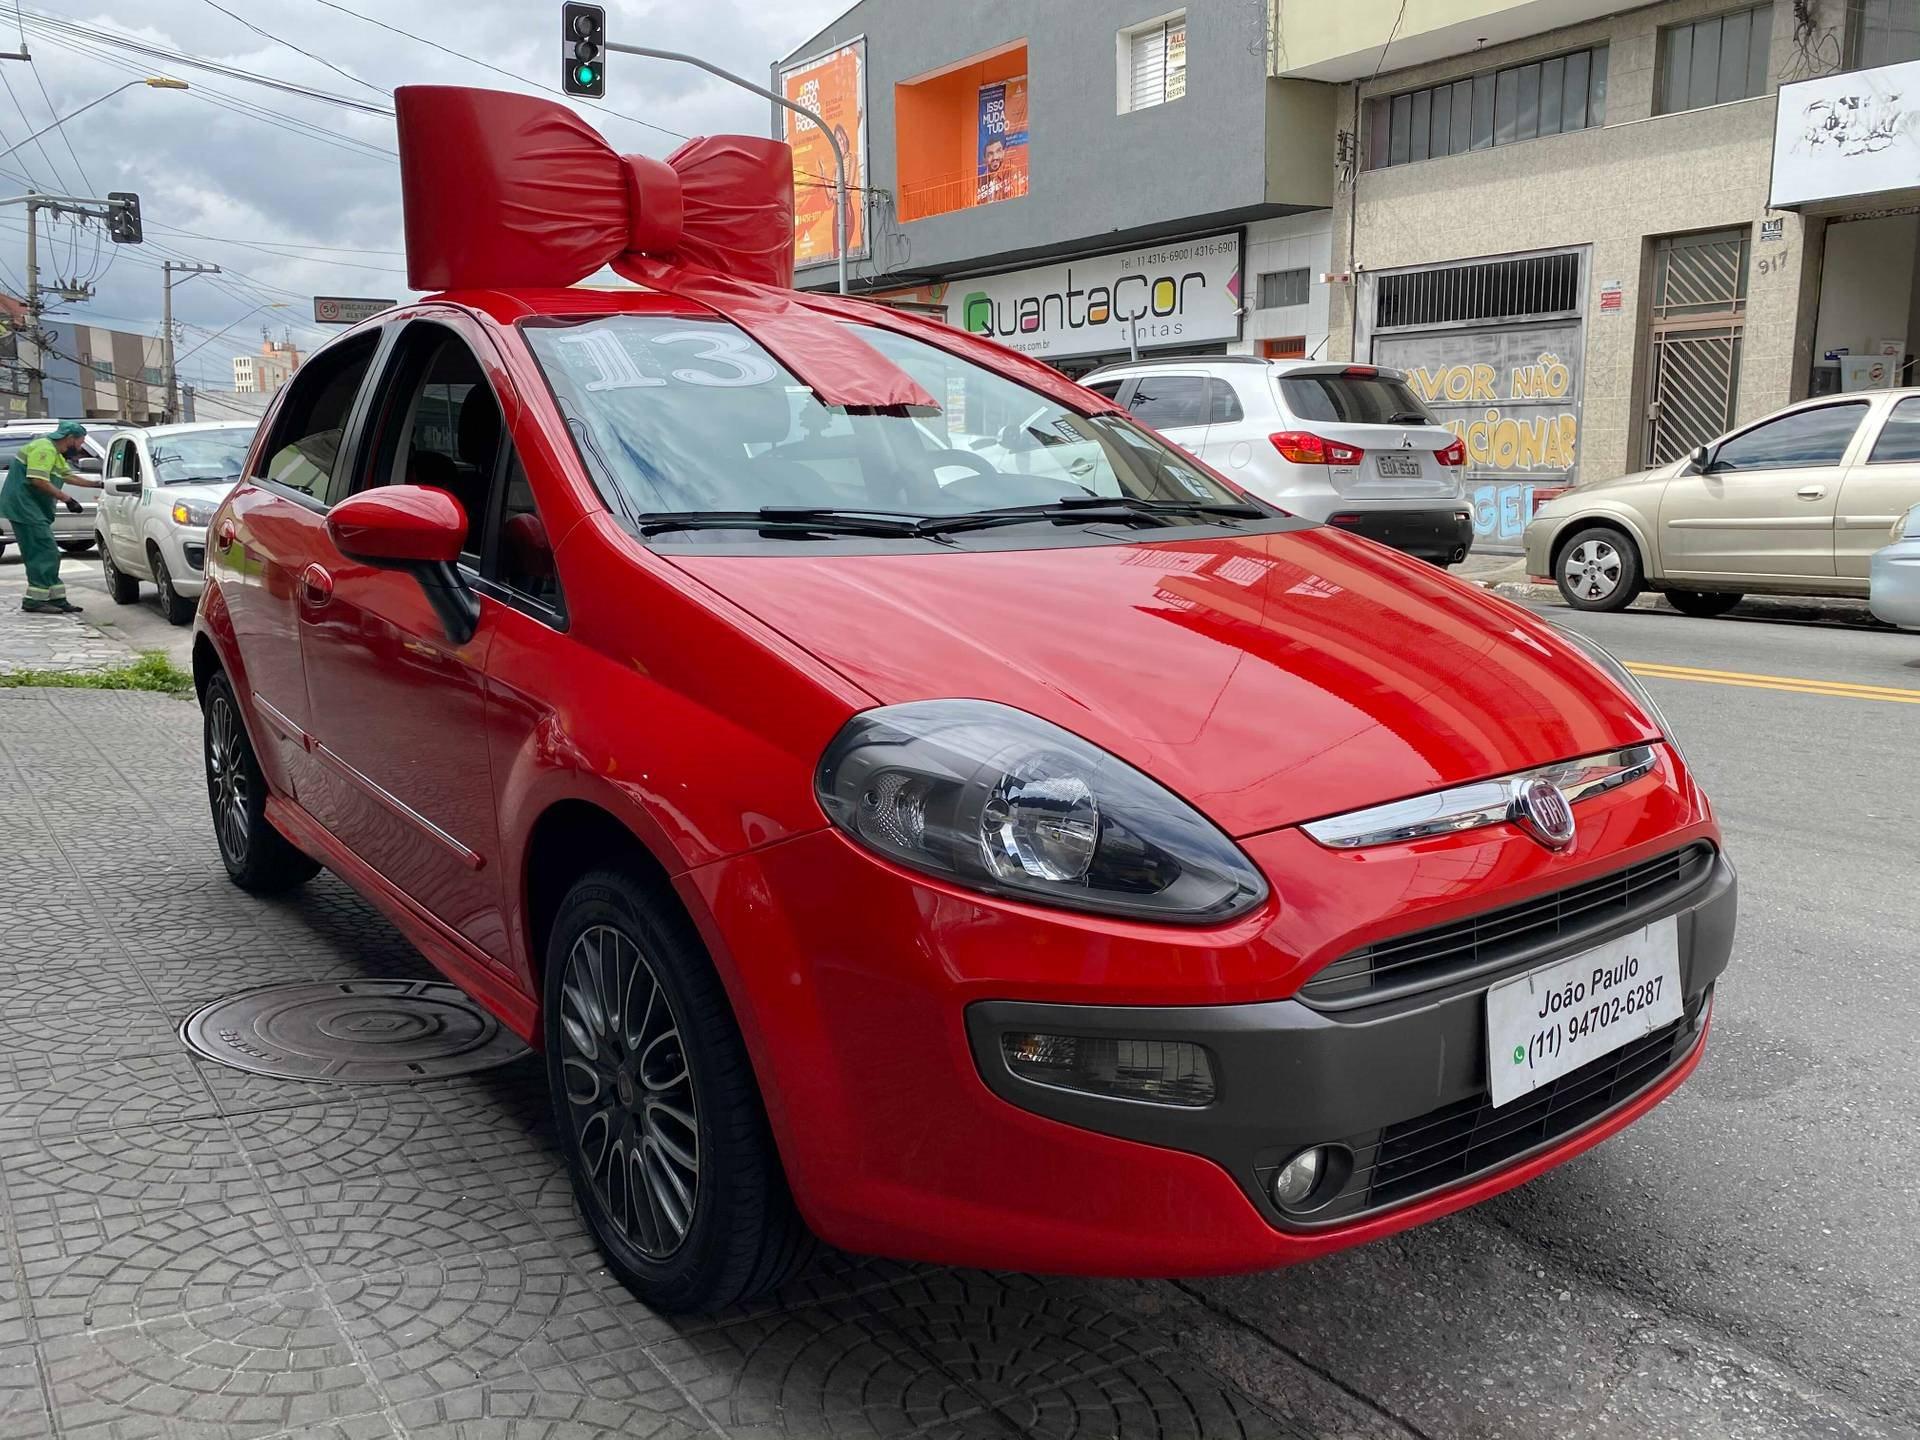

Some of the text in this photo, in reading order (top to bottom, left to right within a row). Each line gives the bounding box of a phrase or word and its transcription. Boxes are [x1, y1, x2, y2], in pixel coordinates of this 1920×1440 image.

[983, 110, 1006, 126] MUDA
[986, 99, 1005, 113] ISSO
[986, 120, 1010, 135] TUDO
[1758, 248, 1789, 275] 917
[323, 305, 336, 314] 50
[1120, 321, 1183, 341] tntas
[559, 328, 778, 393] 13
[1511, 352, 1568, 399] NÃO
[1535, 793, 1568, 827] FIAT
[1538, 955, 1639, 1019] João Paulo
[1528, 975, 1663, 1069] (11) 94702-6287
